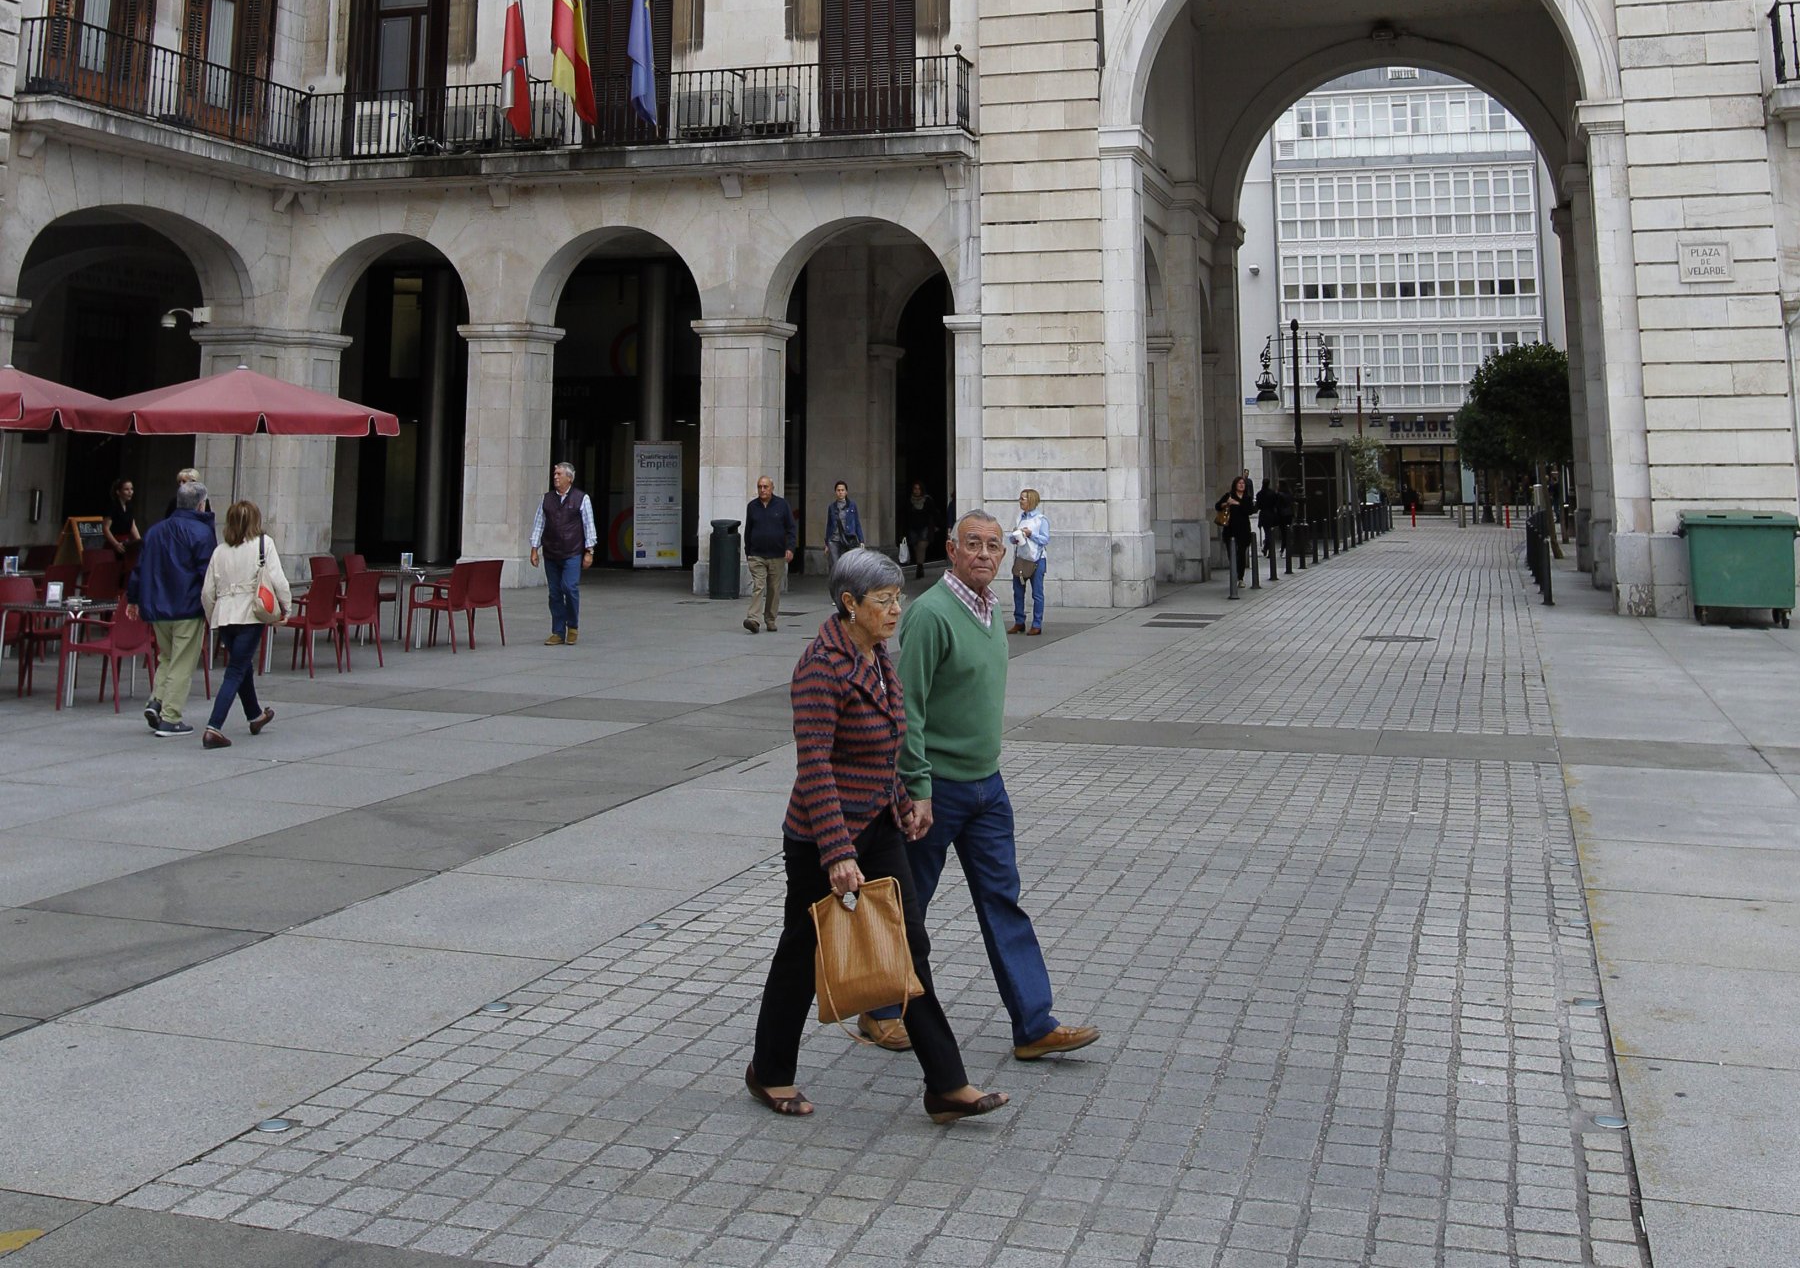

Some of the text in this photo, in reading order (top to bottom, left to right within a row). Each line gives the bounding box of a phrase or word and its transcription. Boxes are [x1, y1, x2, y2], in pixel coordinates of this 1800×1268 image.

[1691, 248, 1720, 257] PLAZA
[1687, 266, 1726, 275] VELARDE
[640, 459, 678, 471] Empleo
